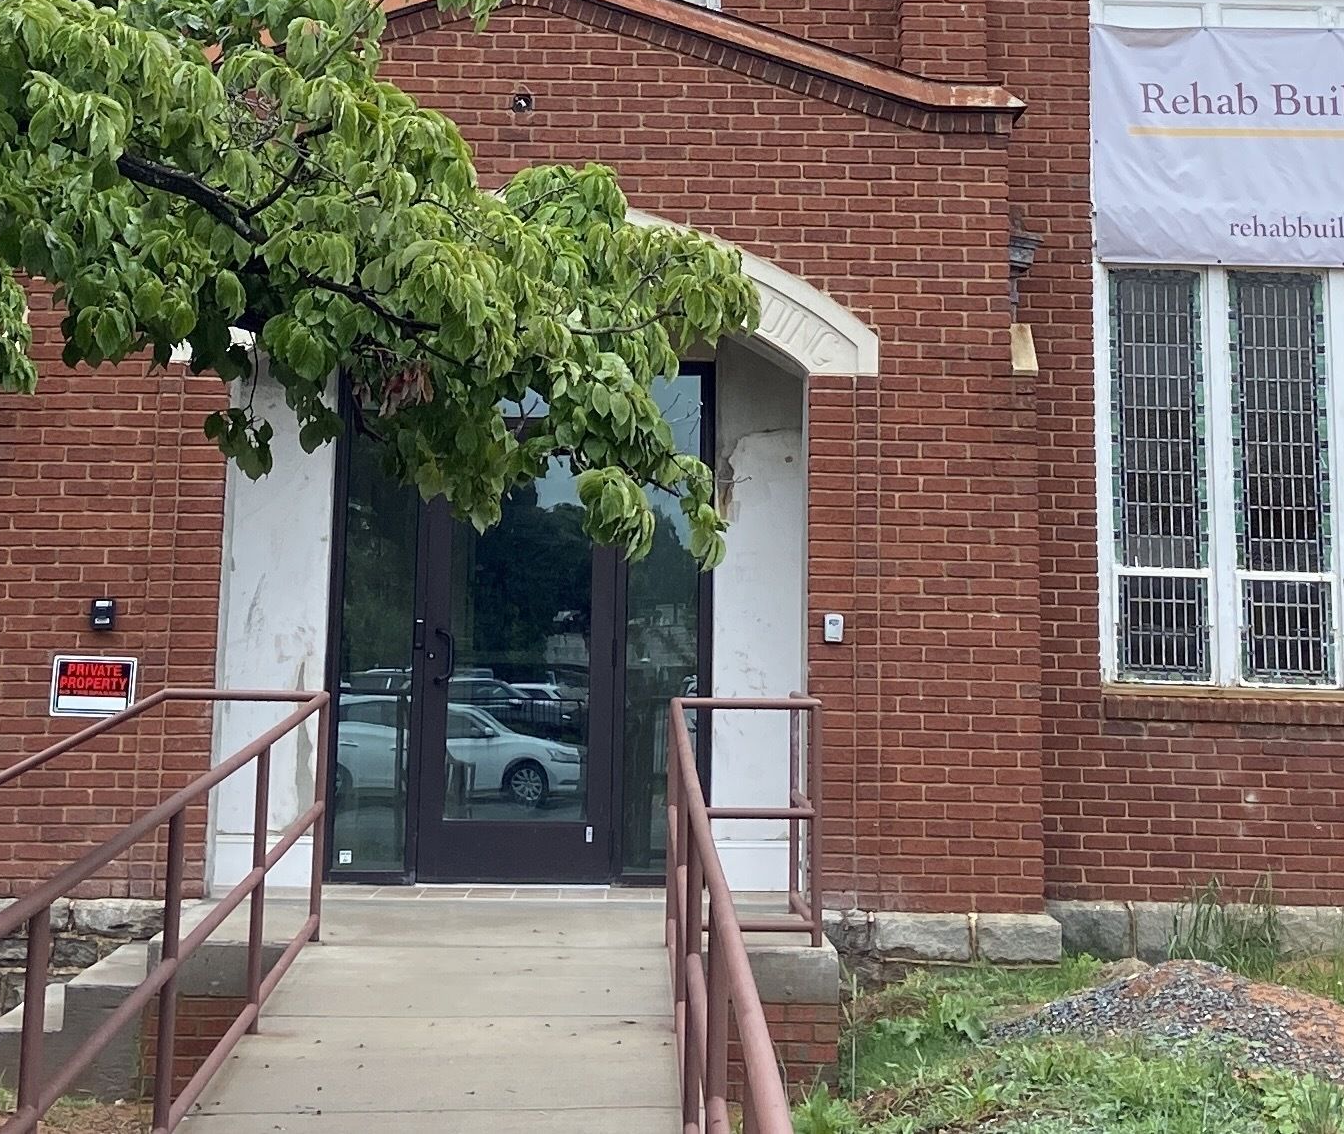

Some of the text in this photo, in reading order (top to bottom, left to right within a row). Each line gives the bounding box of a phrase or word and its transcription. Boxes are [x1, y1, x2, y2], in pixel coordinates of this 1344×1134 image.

[1138, 81, 1258, 116] Rehab
[67, 663, 123, 677] PRIVATE
[59, 676, 128, 691] PROPERTY
